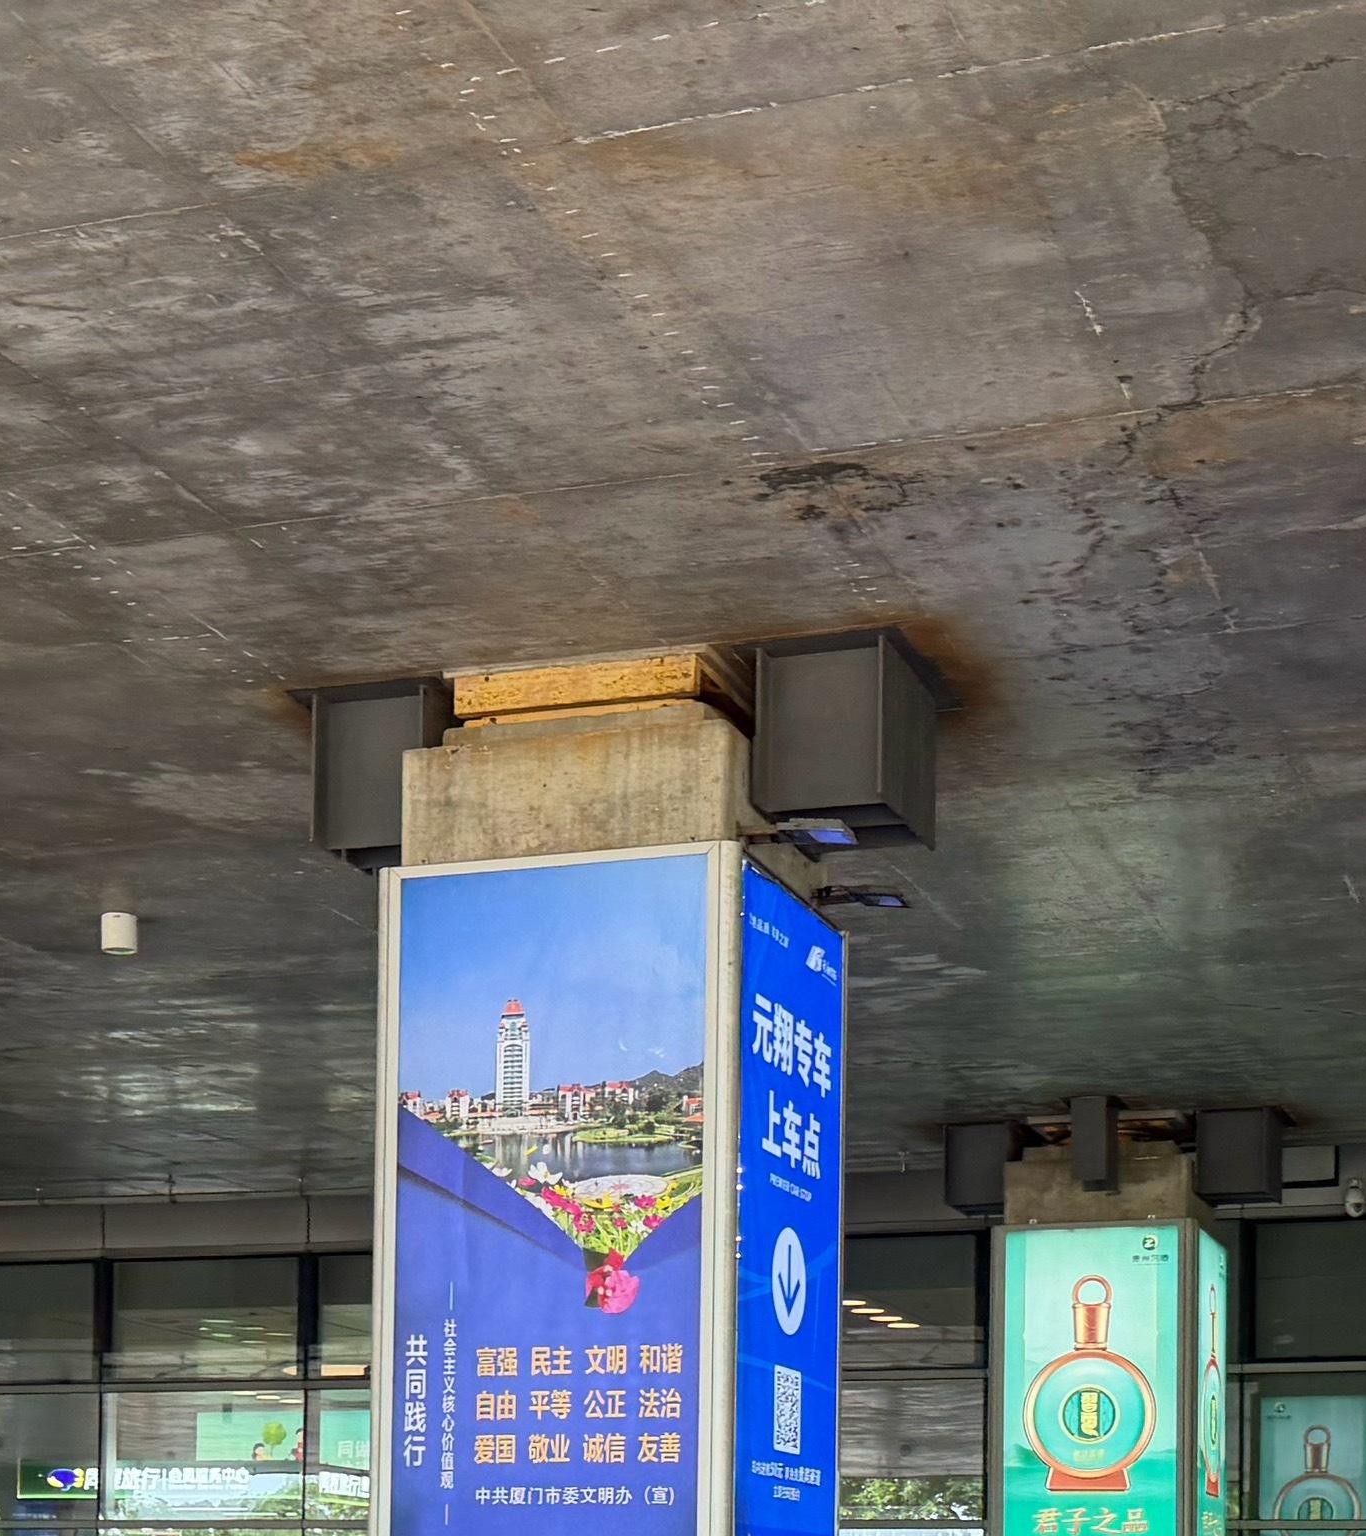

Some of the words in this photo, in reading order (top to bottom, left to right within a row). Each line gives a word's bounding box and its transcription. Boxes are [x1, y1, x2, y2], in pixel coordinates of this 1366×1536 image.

[752, 993, 832, 1098] 元翔专车
[762, 1090, 821, 1180] 上车点
[476, 1347, 517, 1376] 富强
[531, 1346, 572, 1375] 民主
[585, 1345, 627, 1374] 文明
[639, 1343, 683, 1374] 和谐
[404, 1334, 428, 1467] 共同践行
[440, 1319, 457, 1489] 社会主义核心价值观
[475, 1391, 516, 1420] 自由
[529, 1390, 571, 1419] 平等
[584, 1390, 626, 1419] 公正
[638, 1388, 682, 1418] 法治
[474, 1434, 516, 1464] 爱国
[528, 1434, 570, 1463] 敬业
[583, 1433, 626, 1463] 诚信
[637, 1432, 681, 1463] 友善
[1032, 1507, 1148, 1536] 君子之品
